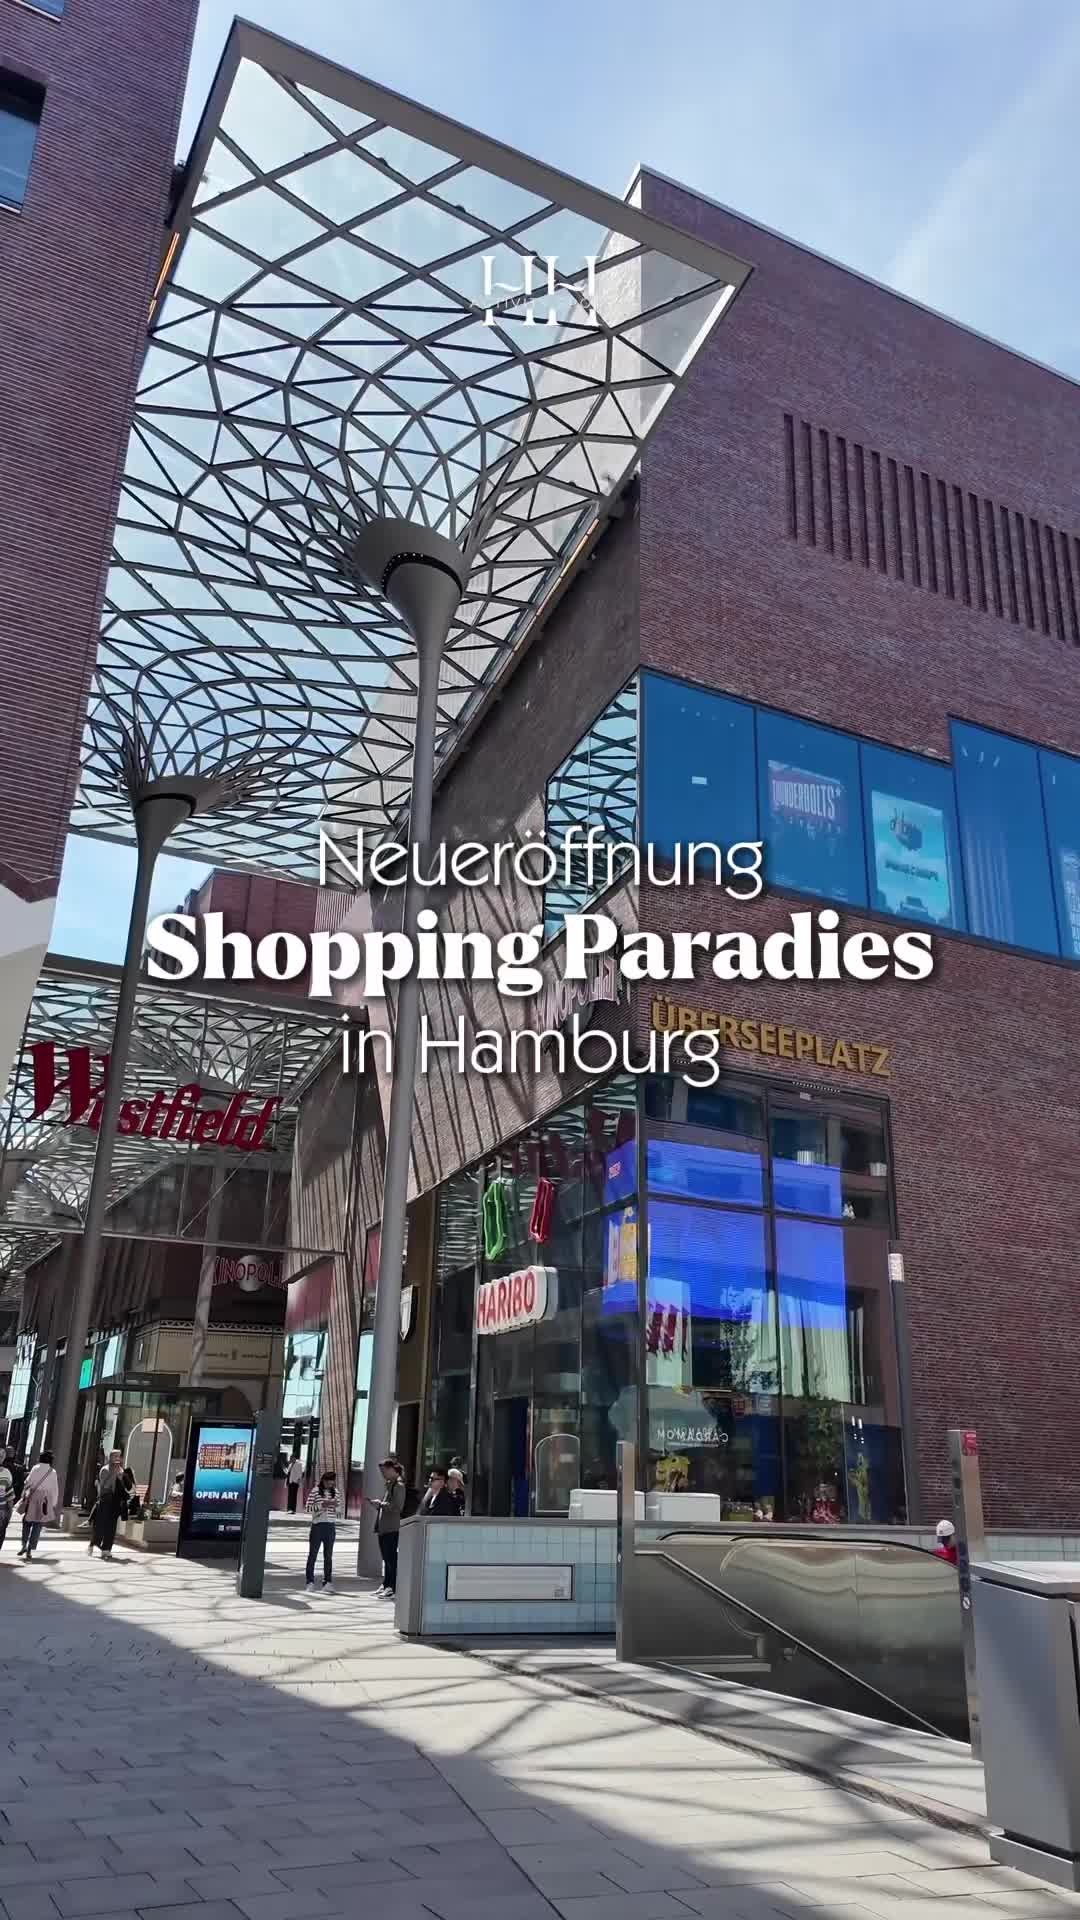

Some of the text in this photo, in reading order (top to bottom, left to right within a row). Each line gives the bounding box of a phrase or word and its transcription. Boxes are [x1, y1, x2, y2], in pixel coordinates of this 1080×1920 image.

[651, 994, 892, 1077] ÜBERSEEPLATZ
[214, 1256, 286, 1288] INOPOLI
[477, 1271, 536, 1329] HARIBO
[195, 1491, 240, 1500] OPEN ART
